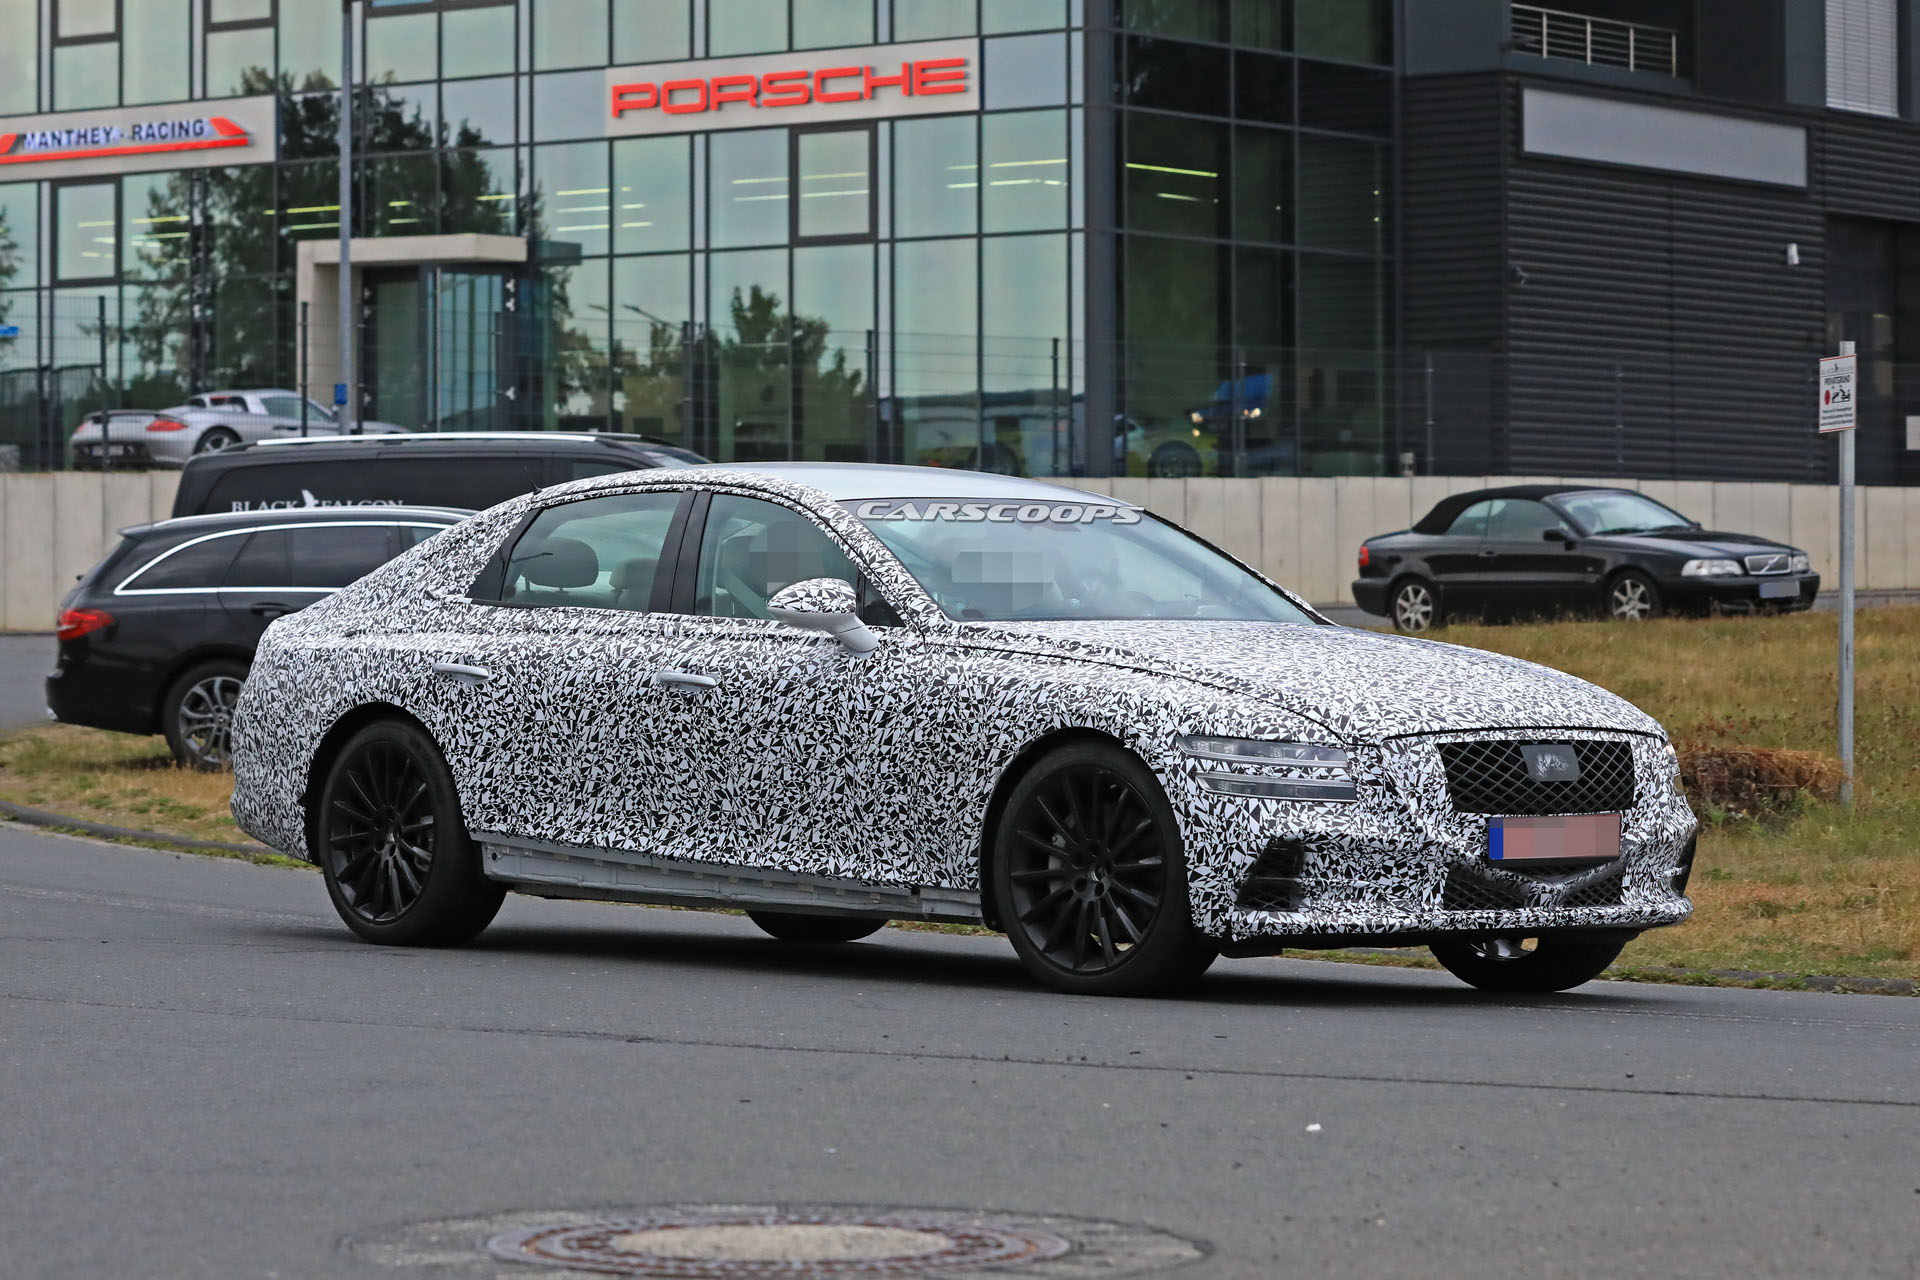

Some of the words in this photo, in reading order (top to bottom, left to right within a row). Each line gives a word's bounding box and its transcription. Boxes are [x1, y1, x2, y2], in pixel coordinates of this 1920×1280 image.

[611, 58, 965, 118] PORSCHE
[24, 127, 114, 150] MANTHEY
[131, 119, 206, 141] RACING
[231, 501, 299, 512] BLACK
